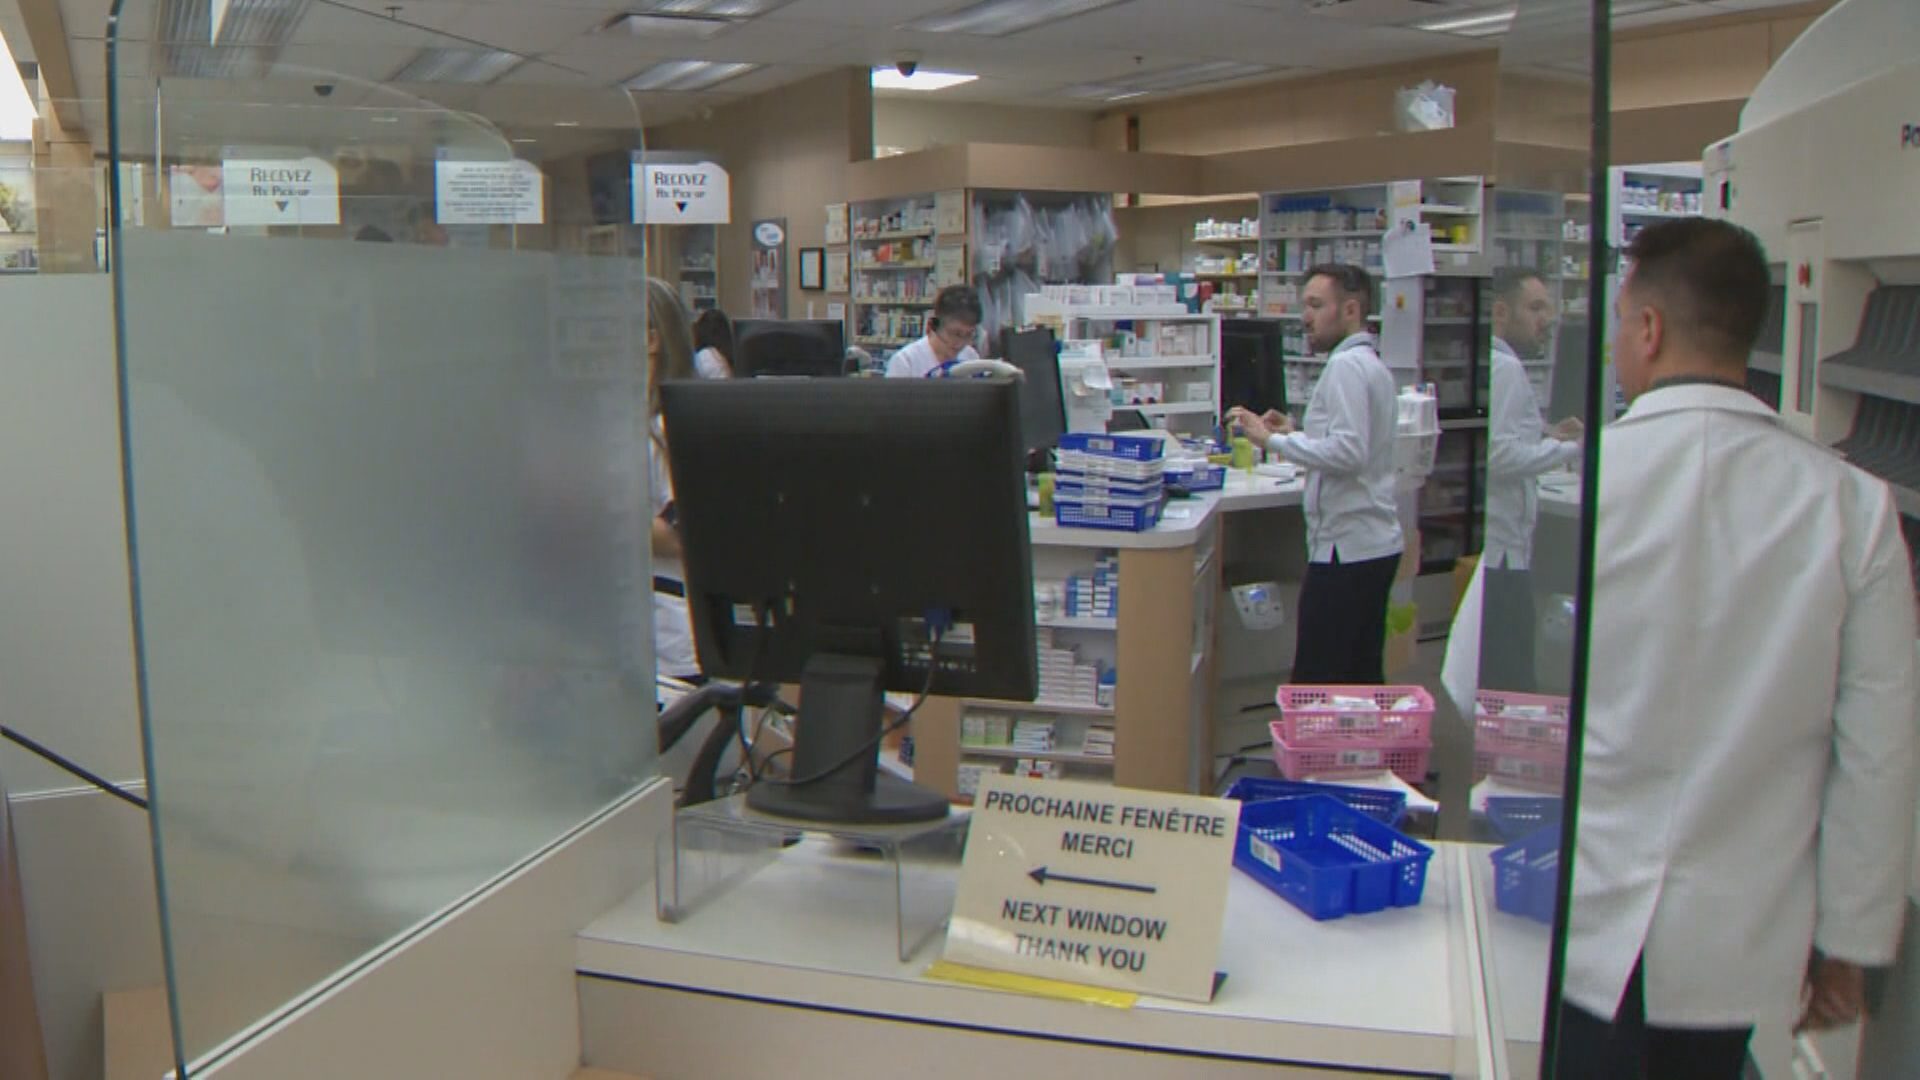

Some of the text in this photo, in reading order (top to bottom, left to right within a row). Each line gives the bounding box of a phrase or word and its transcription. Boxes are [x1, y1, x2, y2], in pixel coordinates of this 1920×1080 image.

[250, 167, 312, 182] RECEVEZ
[654, 171, 708, 186] RECEVEZ
[984, 790, 1226, 838] PROCHAINE FENÊTRE
[1060, 832, 1134, 860] MERCI
[1002, 899, 1168, 942] NEXT WINDOW
[1014, 934, 1146, 973] THANK YOU
